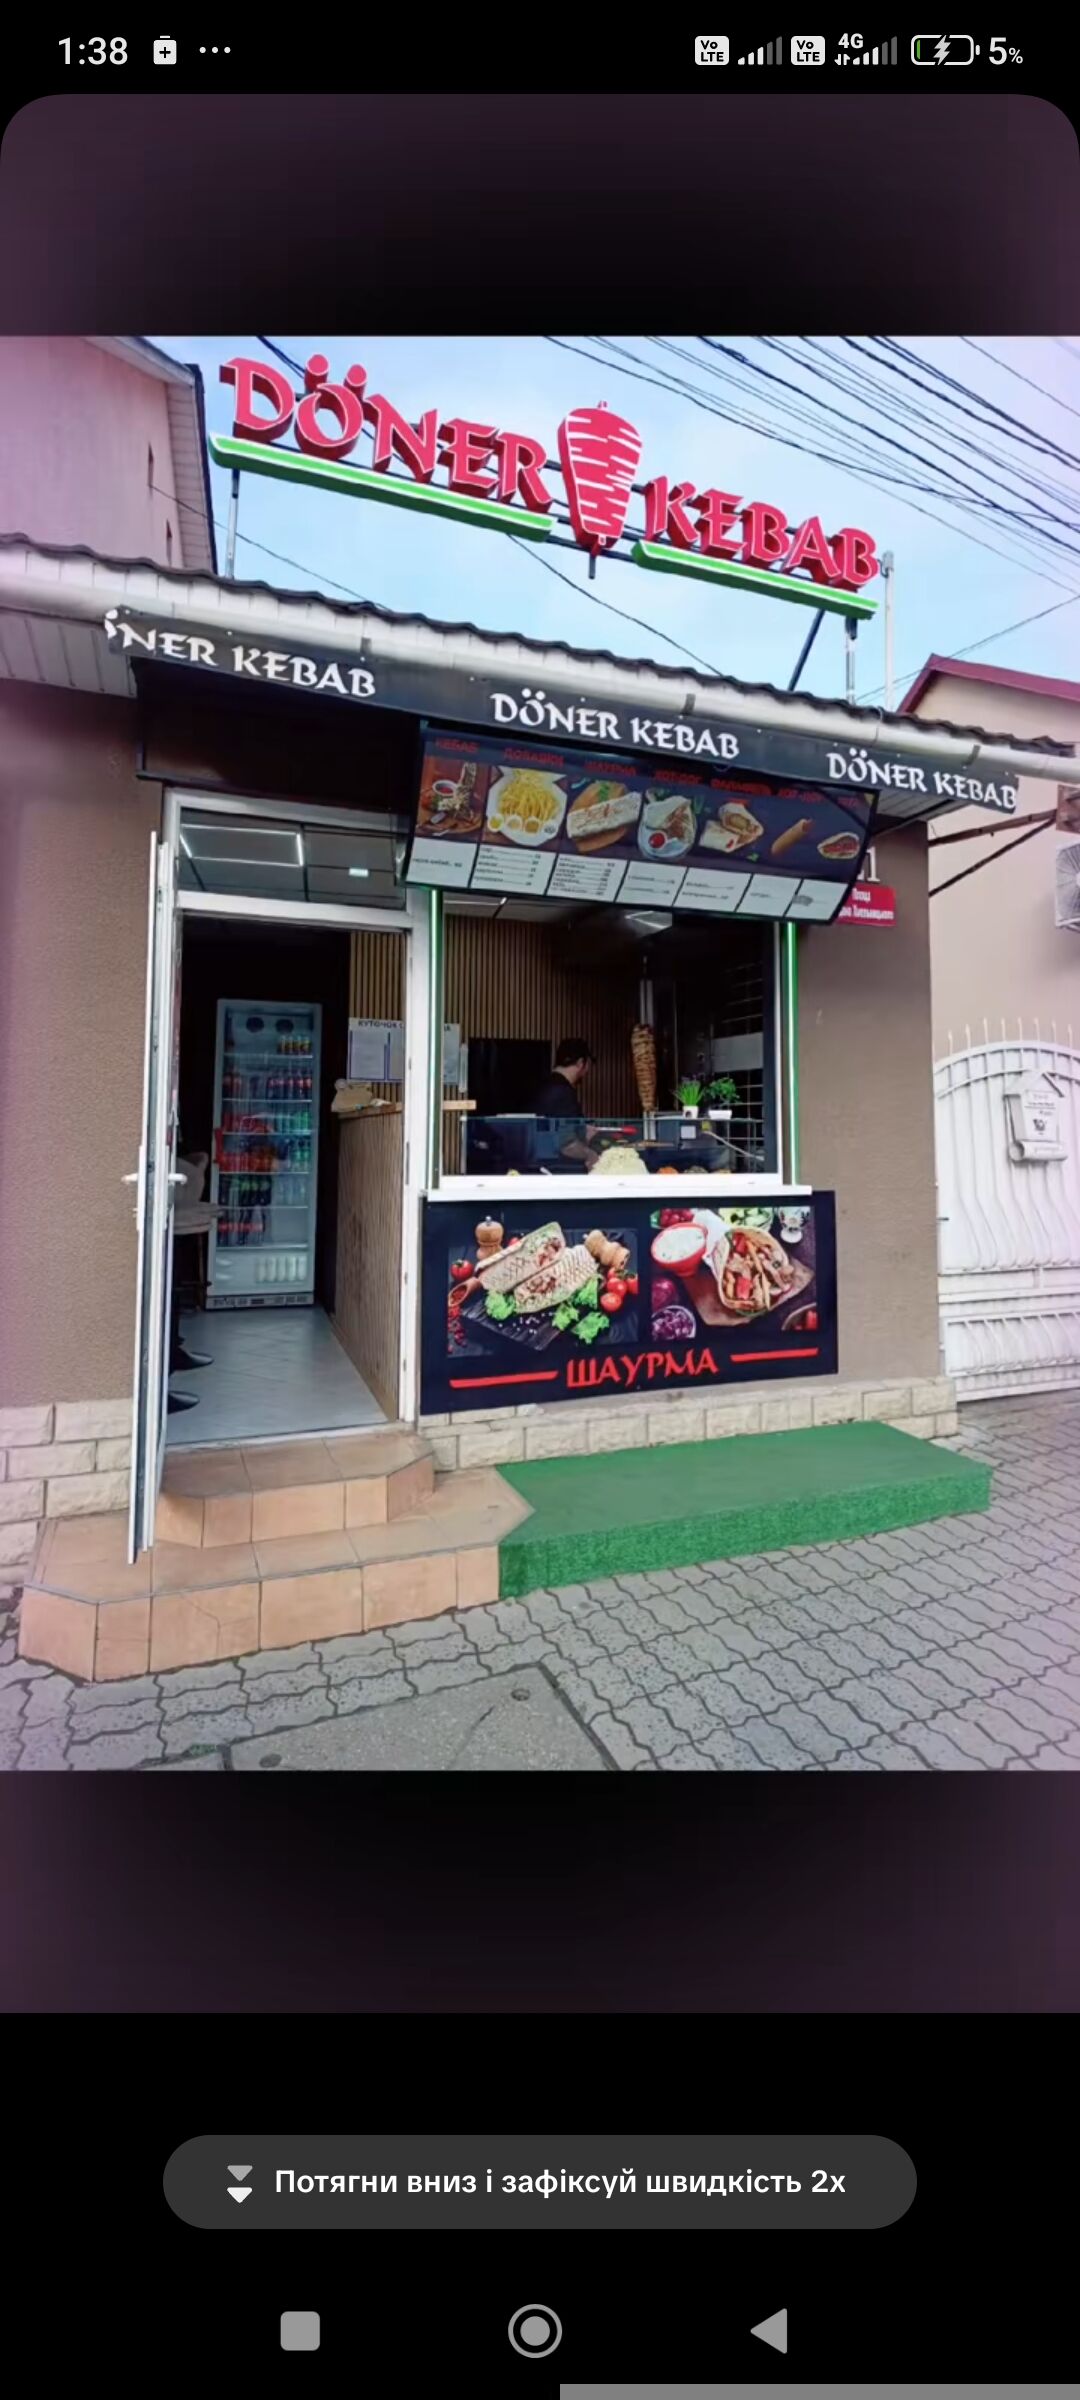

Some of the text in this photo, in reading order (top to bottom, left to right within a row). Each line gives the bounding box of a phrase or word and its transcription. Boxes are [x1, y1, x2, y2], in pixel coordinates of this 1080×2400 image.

[221, 354, 880, 590] DÖNER KEBAB
[231, 645, 376, 698] KEBAB
[490, 688, 740, 760] DÖNER KEBAB
[826, 747, 1017, 810] DÖNER KEBAB
[567, 1348, 719, 1390] ШАУРМА
